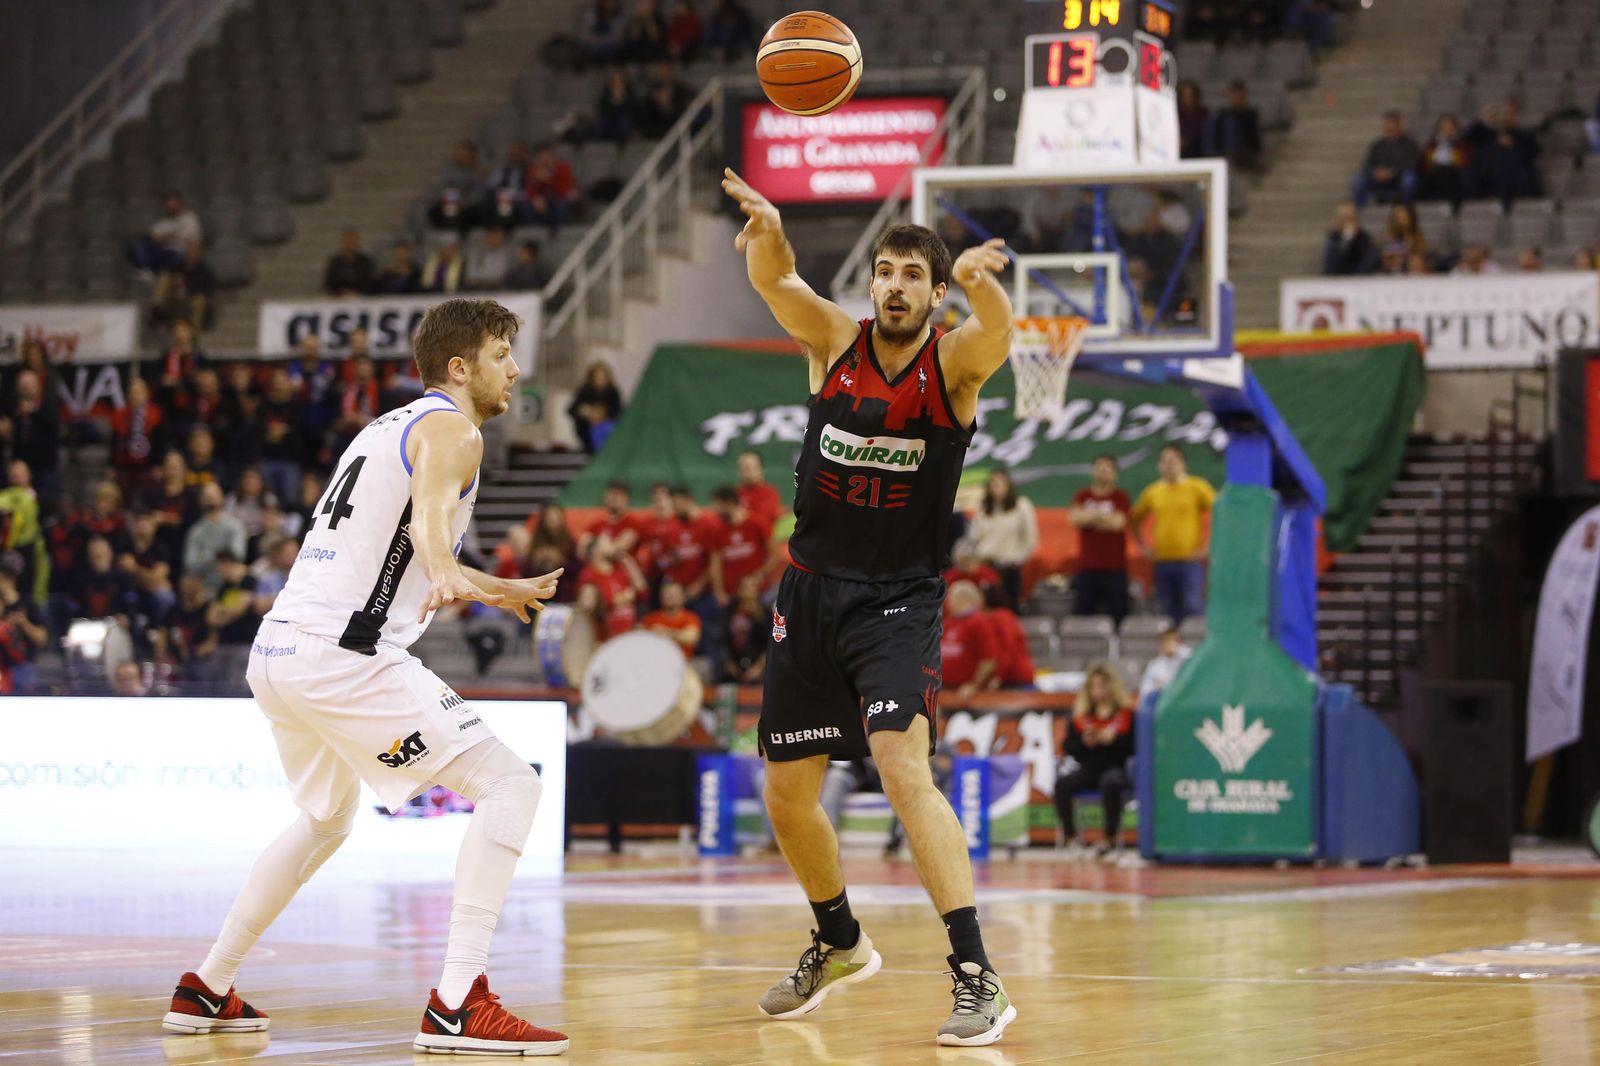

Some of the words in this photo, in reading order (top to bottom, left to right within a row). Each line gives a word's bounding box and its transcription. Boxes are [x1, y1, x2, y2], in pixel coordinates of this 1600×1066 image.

[1047, 36, 1096, 88] 13
[287, 312, 425, 350] asis
[846, 475, 881, 508] 21
[785, 727, 842, 744] BERNER
